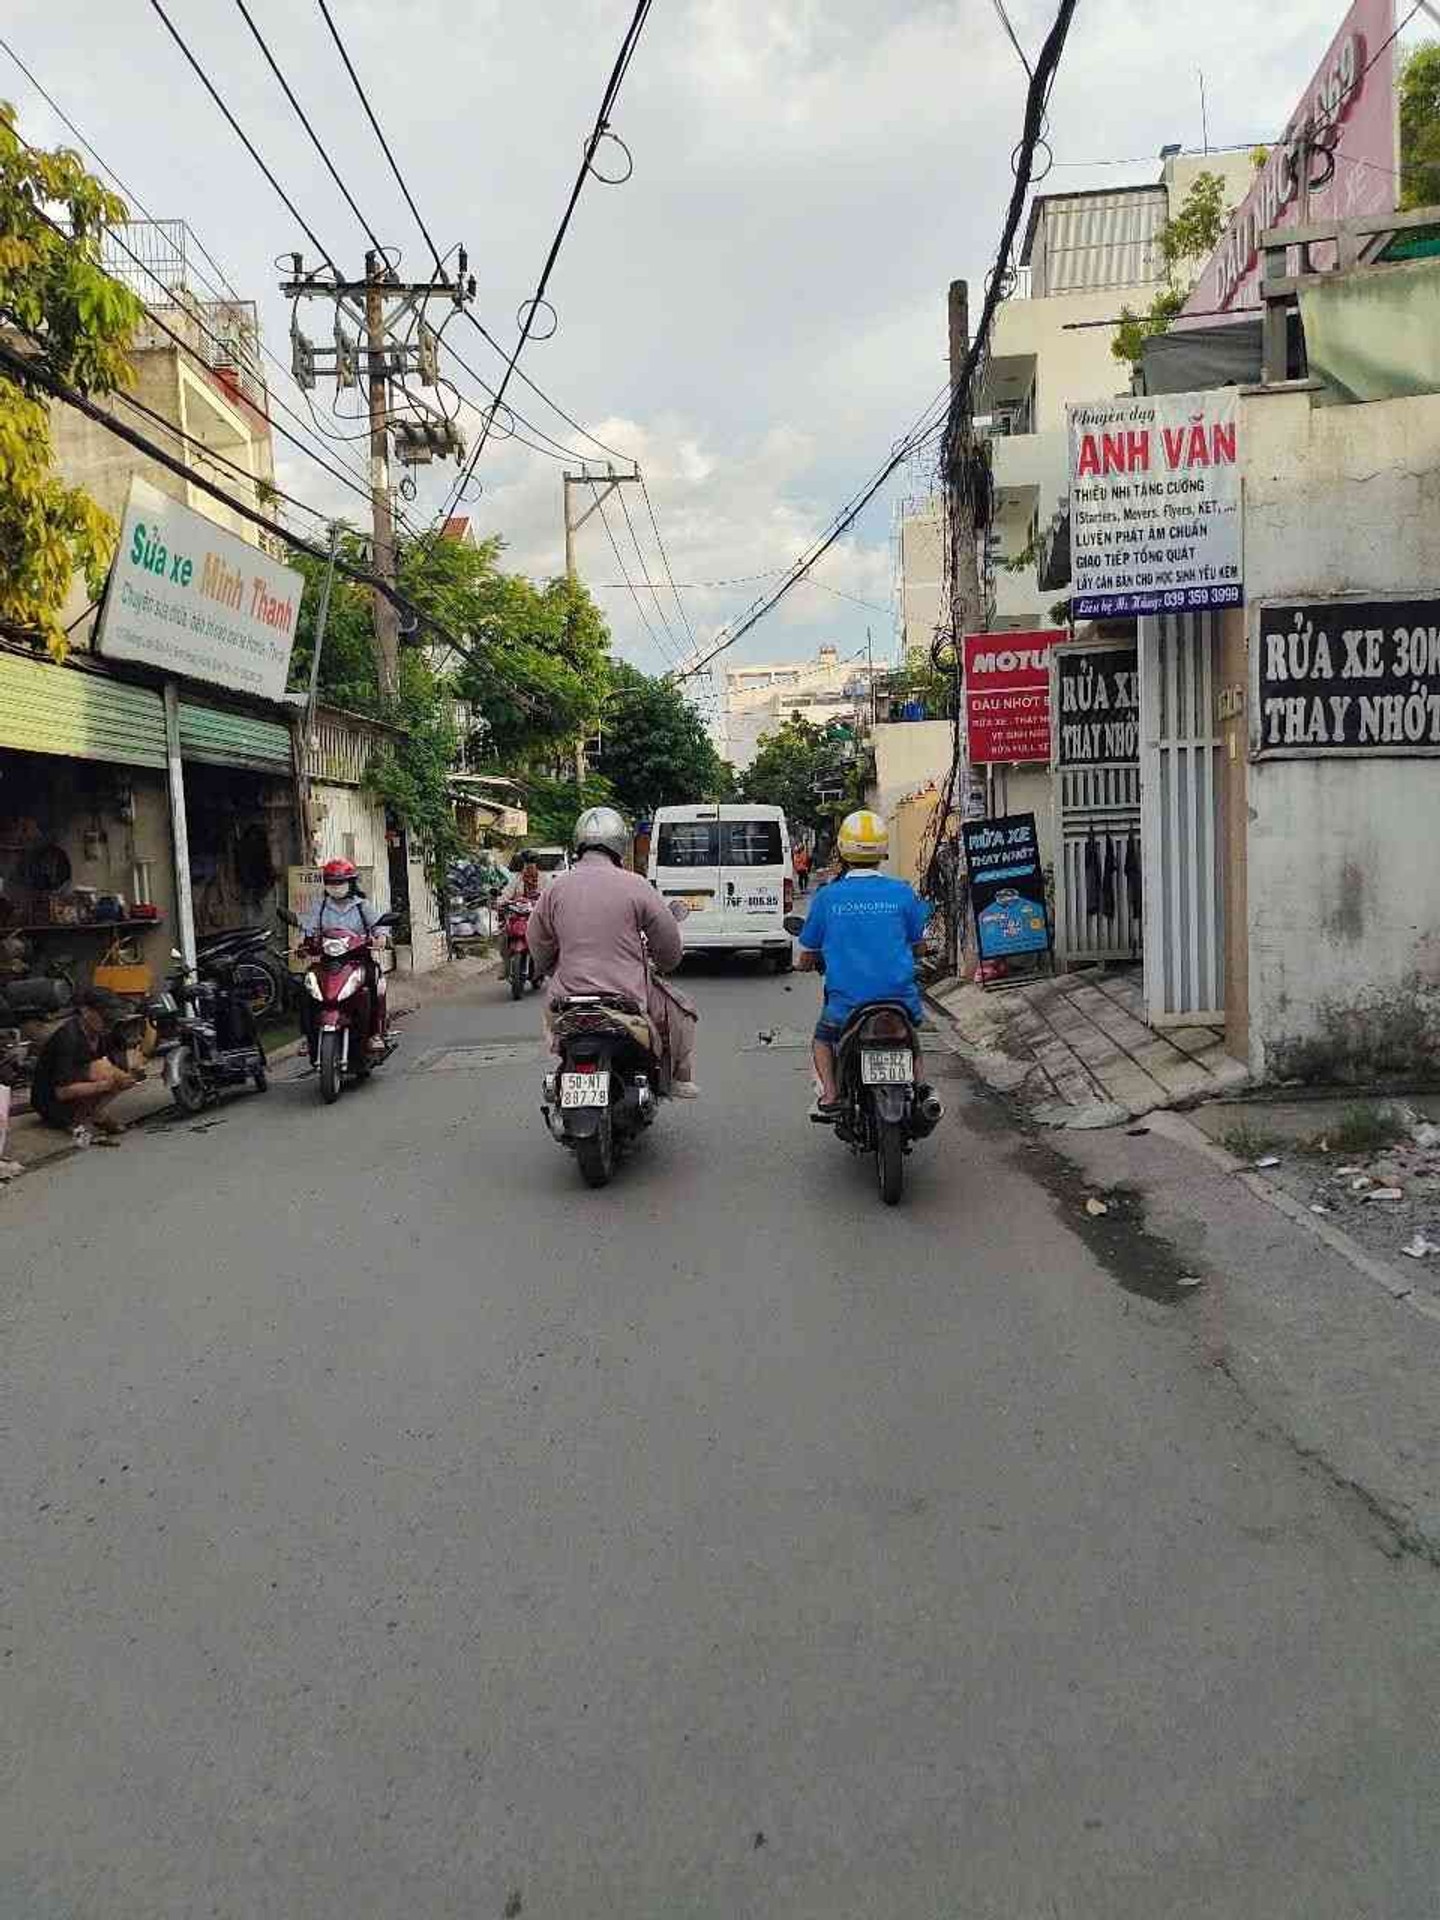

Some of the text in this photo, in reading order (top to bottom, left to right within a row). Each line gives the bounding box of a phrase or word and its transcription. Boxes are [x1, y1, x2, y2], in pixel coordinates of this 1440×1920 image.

[1078, 414, 1237, 476] ANH VĂN
[1111, 486, 1131, 500] NHI
[130, 522, 293, 634] Sửa xe Minh Thanh
[1075, 554, 1101, 569] GIAO
[1163, 591, 1185, 607] 039
[1187, 589, 1209, 605] 359
[972, 648, 1054, 674] MOTU
[1265, 611, 1334, 682] RỬA
[1341, 628, 1385, 679] XE
[1061, 656, 1110, 712] RỬA
[1060, 711, 1139, 760] THAY NHỚ
[1264, 679, 1440, 744] THAY NHỚT
